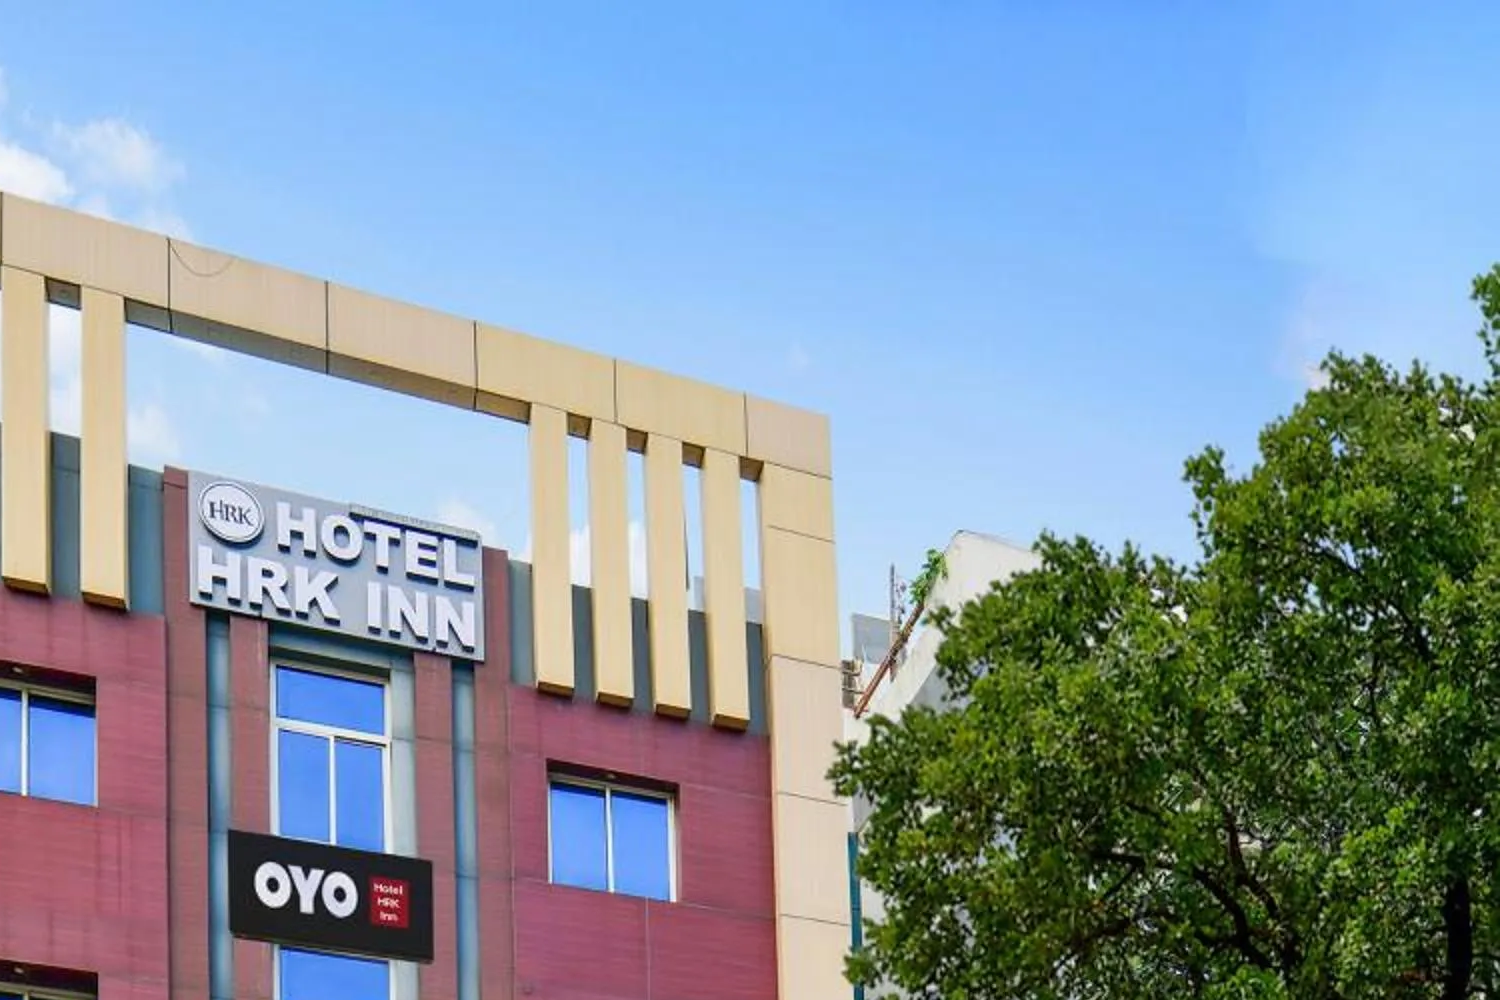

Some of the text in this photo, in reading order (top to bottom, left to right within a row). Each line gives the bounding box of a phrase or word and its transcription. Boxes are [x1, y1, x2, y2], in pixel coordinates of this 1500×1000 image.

[209, 499, 254, 527] HRK
[277, 501, 477, 592] HOTEL
[198, 545, 476, 652] HRK INN
[254, 861, 358, 918] OYO
[373, 882, 404, 895] Hotel
[377, 897, 400, 909] HRK
[379, 910, 399, 922] Inn
